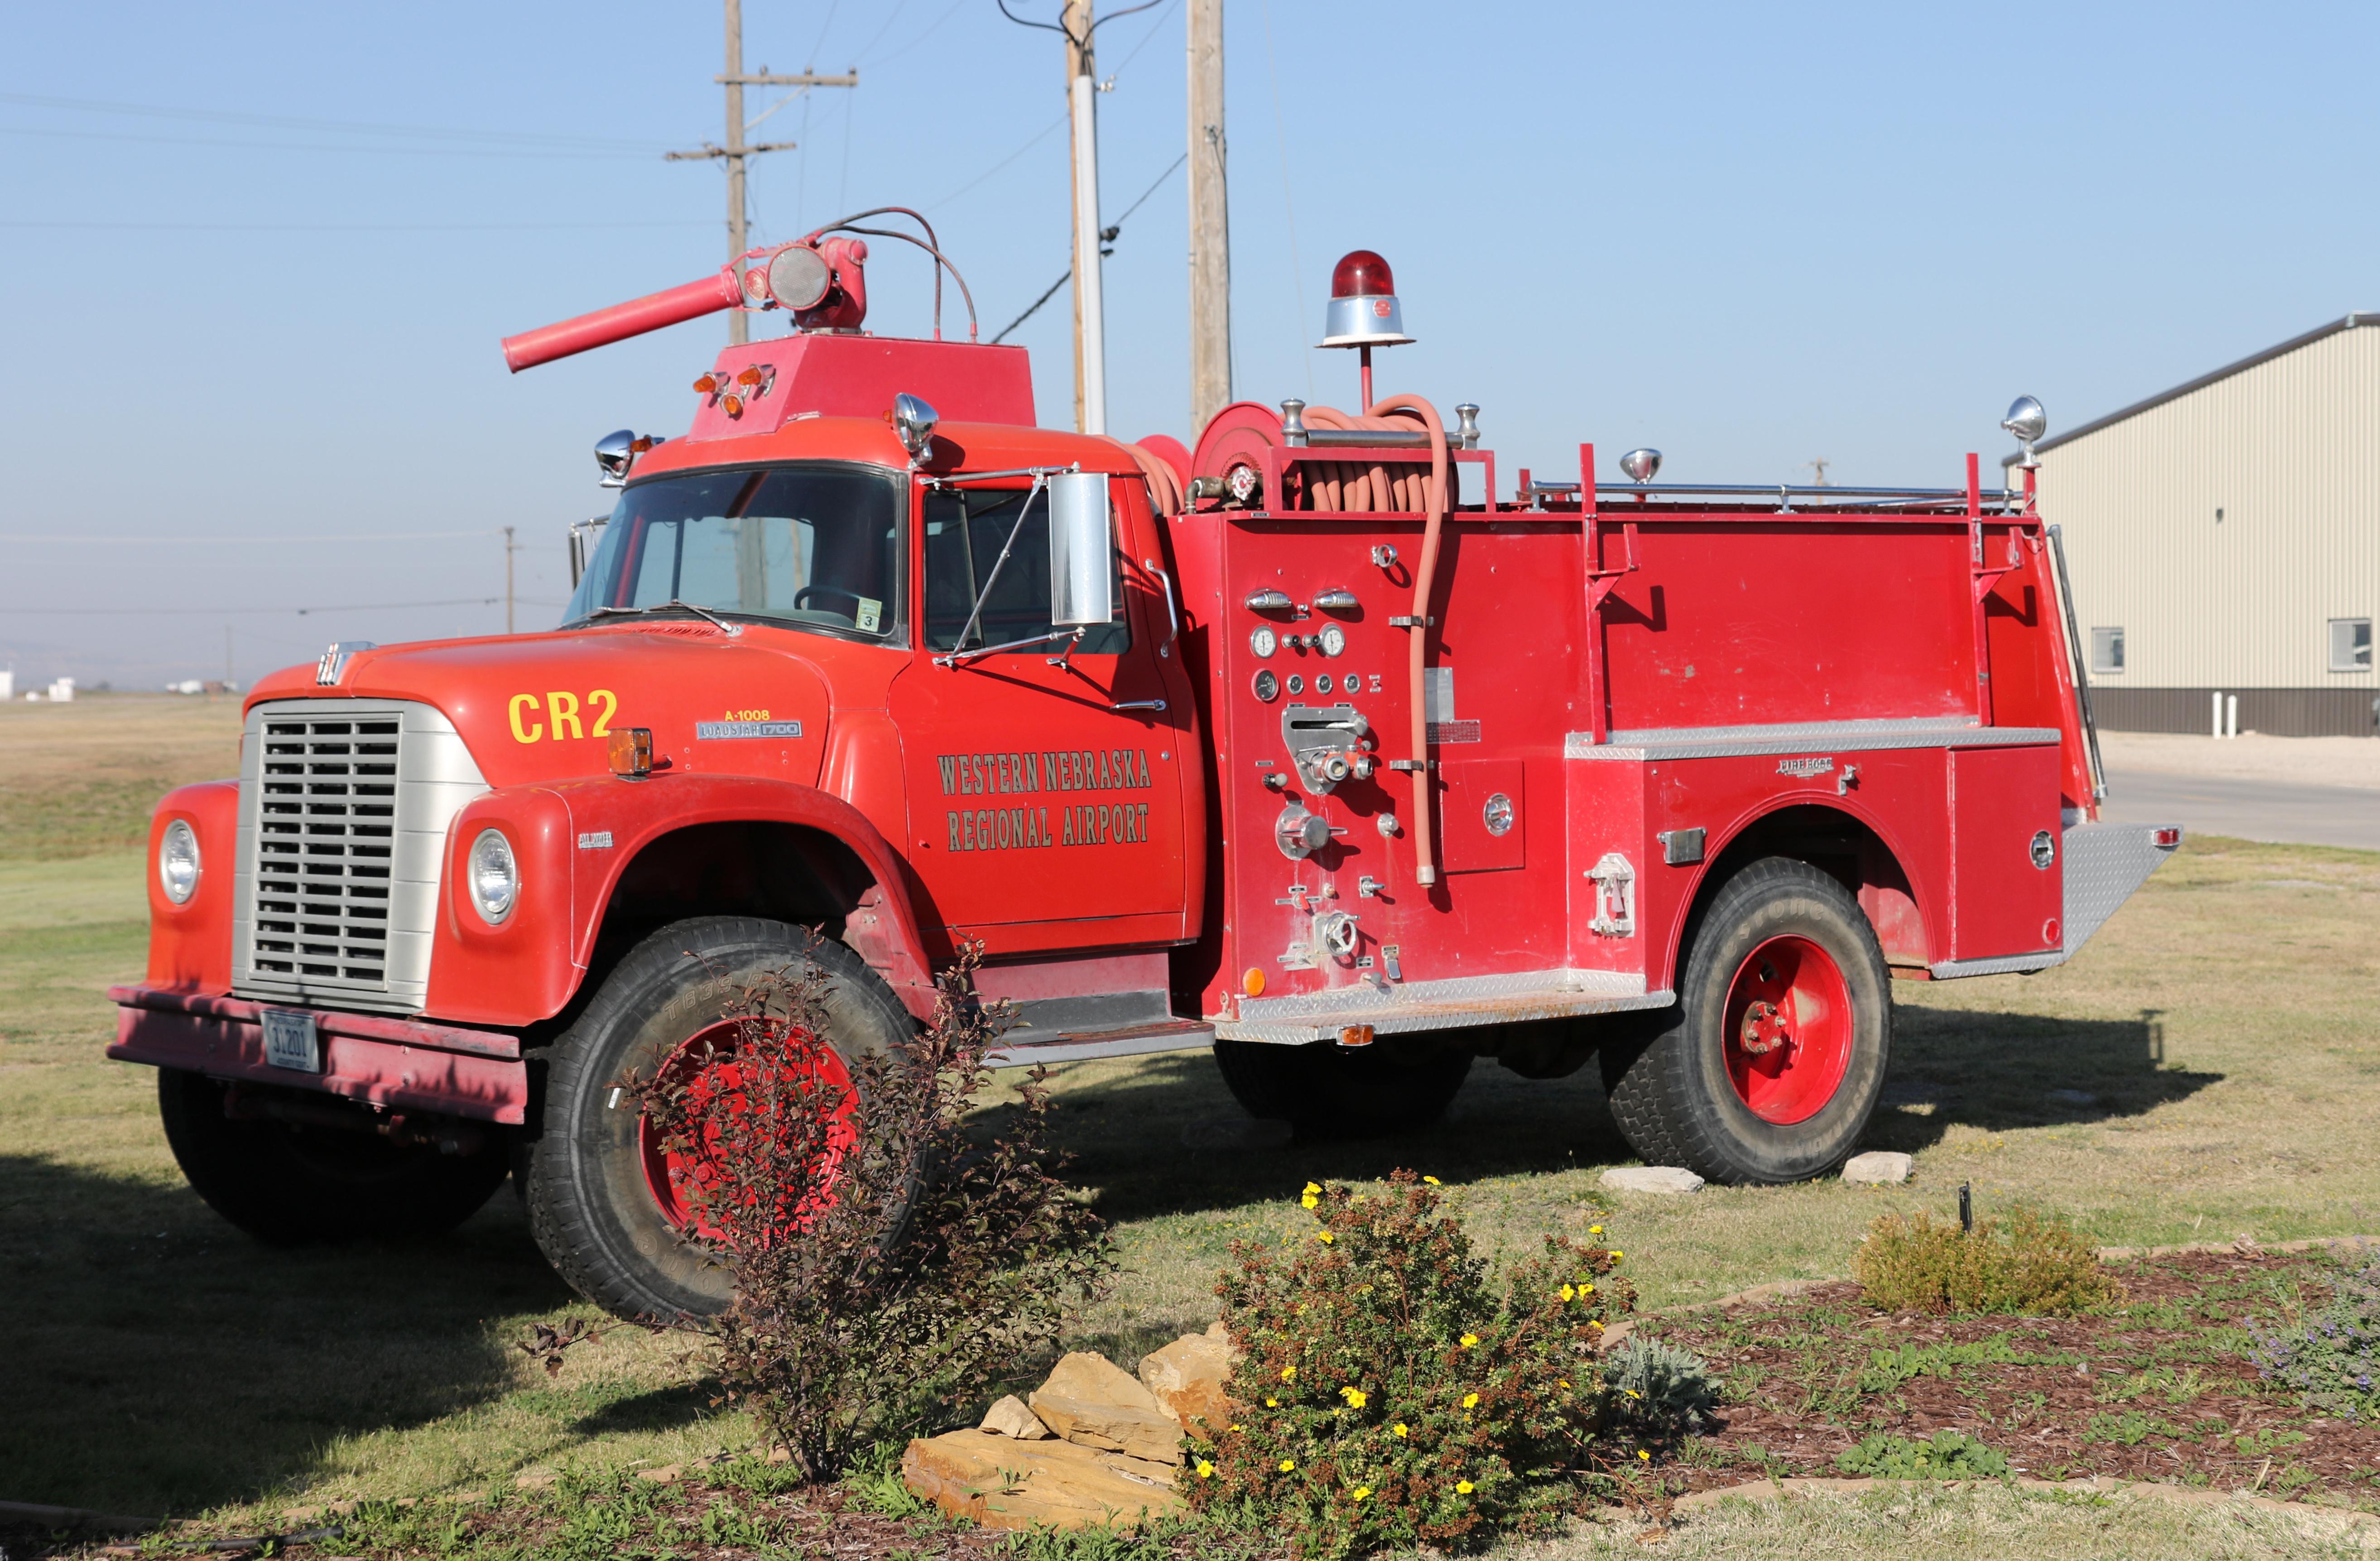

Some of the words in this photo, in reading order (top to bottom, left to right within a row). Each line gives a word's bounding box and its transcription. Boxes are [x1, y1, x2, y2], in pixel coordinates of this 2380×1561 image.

[864, 616, 872, 626] 3
[508, 689, 617, 744] CR2
[702, 723, 760, 737] LOADSTAR
[762, 724, 797, 735] 1700
[937, 752, 1039, 796] WESTERN
[1043, 749, 1152, 792] NEBRASKA
[947, 807, 1052, 852] REGIONAL
[1062, 803, 1148, 846] AIRPORT
[664, 976, 733, 1021] T839
[273, 1027, 307, 1057] 31201
